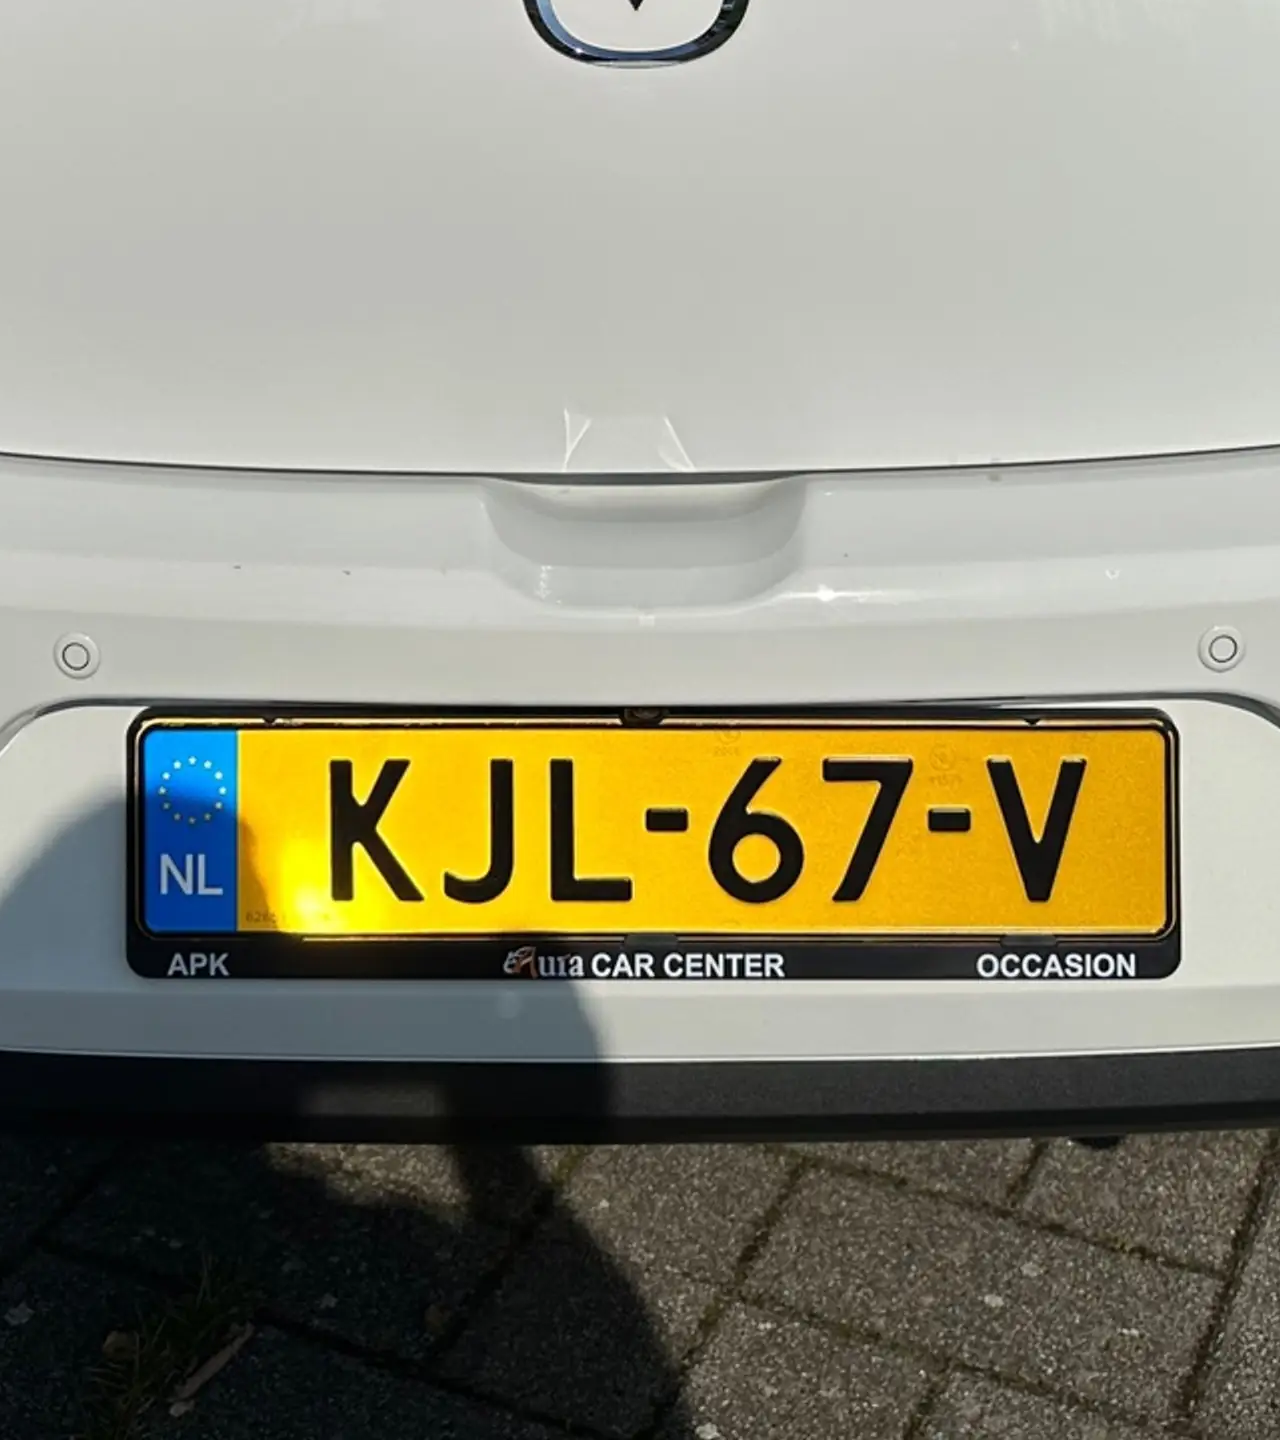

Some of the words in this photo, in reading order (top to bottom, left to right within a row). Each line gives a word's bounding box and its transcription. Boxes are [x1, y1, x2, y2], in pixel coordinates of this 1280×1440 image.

[329, 756, 1088, 902] KJL-67-V
[160, 854, 224, 896] NL
[167, 952, 230, 977] APK
[591, 953, 655, 978] CAR
[663, 953, 786, 978] CENTER
[976, 953, 1136, 978] OCCASION
